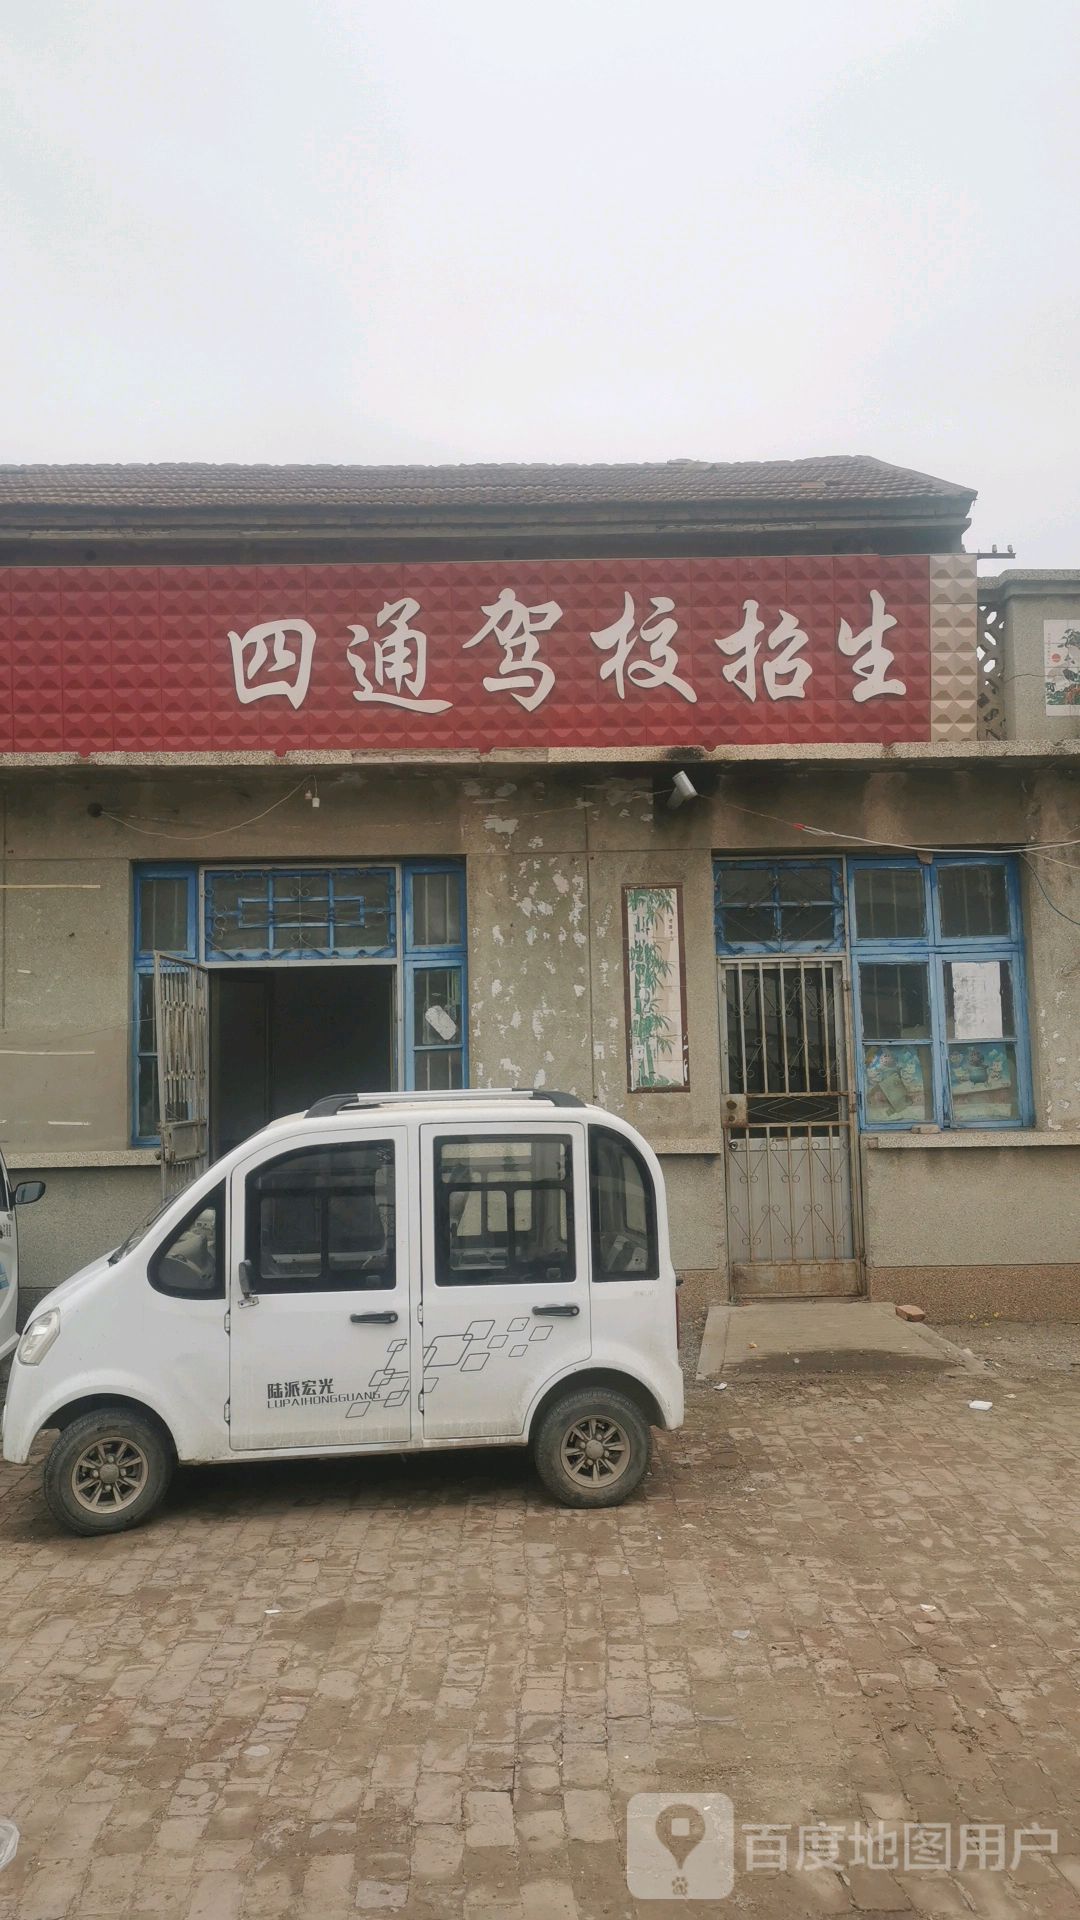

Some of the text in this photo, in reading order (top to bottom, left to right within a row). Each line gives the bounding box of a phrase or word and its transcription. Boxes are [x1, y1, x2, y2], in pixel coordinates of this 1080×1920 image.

[227, 588, 907, 713] 四通驾校招生
[267, 1378, 334, 1399] 陆派宏光
[267, 1392, 381, 1409] LUPAIHONGGUANG
